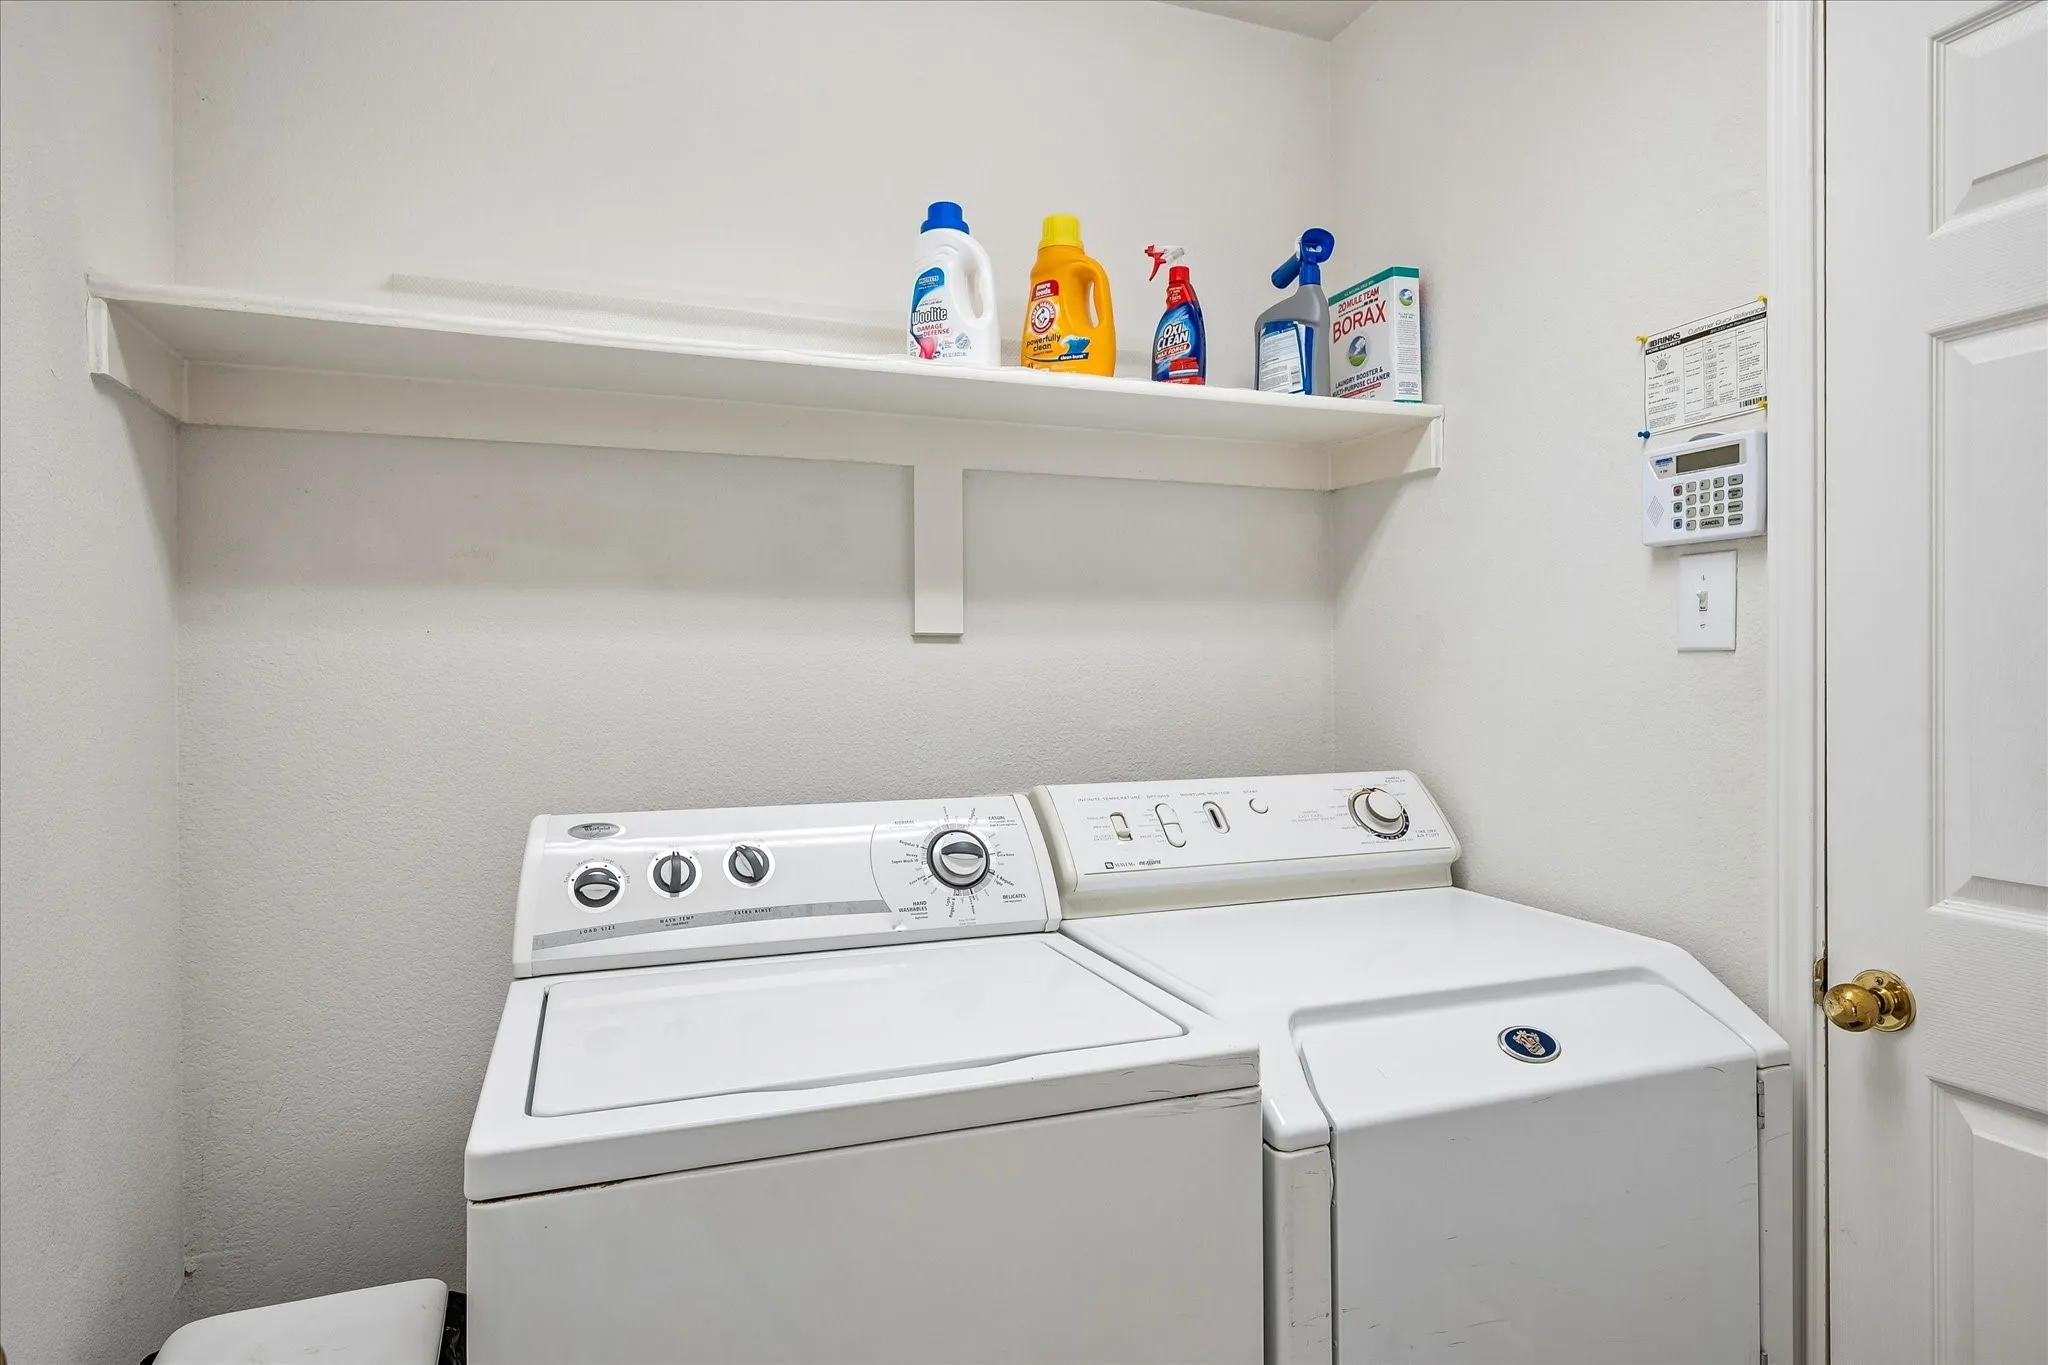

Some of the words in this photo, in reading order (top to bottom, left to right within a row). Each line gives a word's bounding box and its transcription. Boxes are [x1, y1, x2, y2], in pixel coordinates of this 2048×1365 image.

[1338, 302, 1347, 313] 20
[1347, 294, 1362, 308] MULE
[1364, 286, 1380, 300] TEAM
[911, 306, 948, 326] Woolite
[1333, 300, 1386, 344] BORAX
[917, 323, 943, 333] DAMAGE
[923, 328, 950, 337] DEFENSE
[1163, 321, 1184, 338] OXI
[1688, 322, 1713, 335] Customer
[1715, 316, 1733, 326] Quick
[1026, 334, 1061, 348] powerfully
[1157, 330, 1190, 351] CLEAN
[1650, 331, 1680, 348] BRINKS
[1033, 343, 1052, 352] clean
[1168, 344, 1188, 355] FORCE
[1335, 375, 1356, 389] LAUNDRY
[1355, 368, 1379, 380] BOOSTER
[1367, 371, 1391, 386] CLEANER
[1701, 519, 1720, 527] CANCEL
[1002, 892, 1026, 900] DELICATES
[579, 927, 598, 935] LOAD
[601, 924, 616, 932] SIZE
